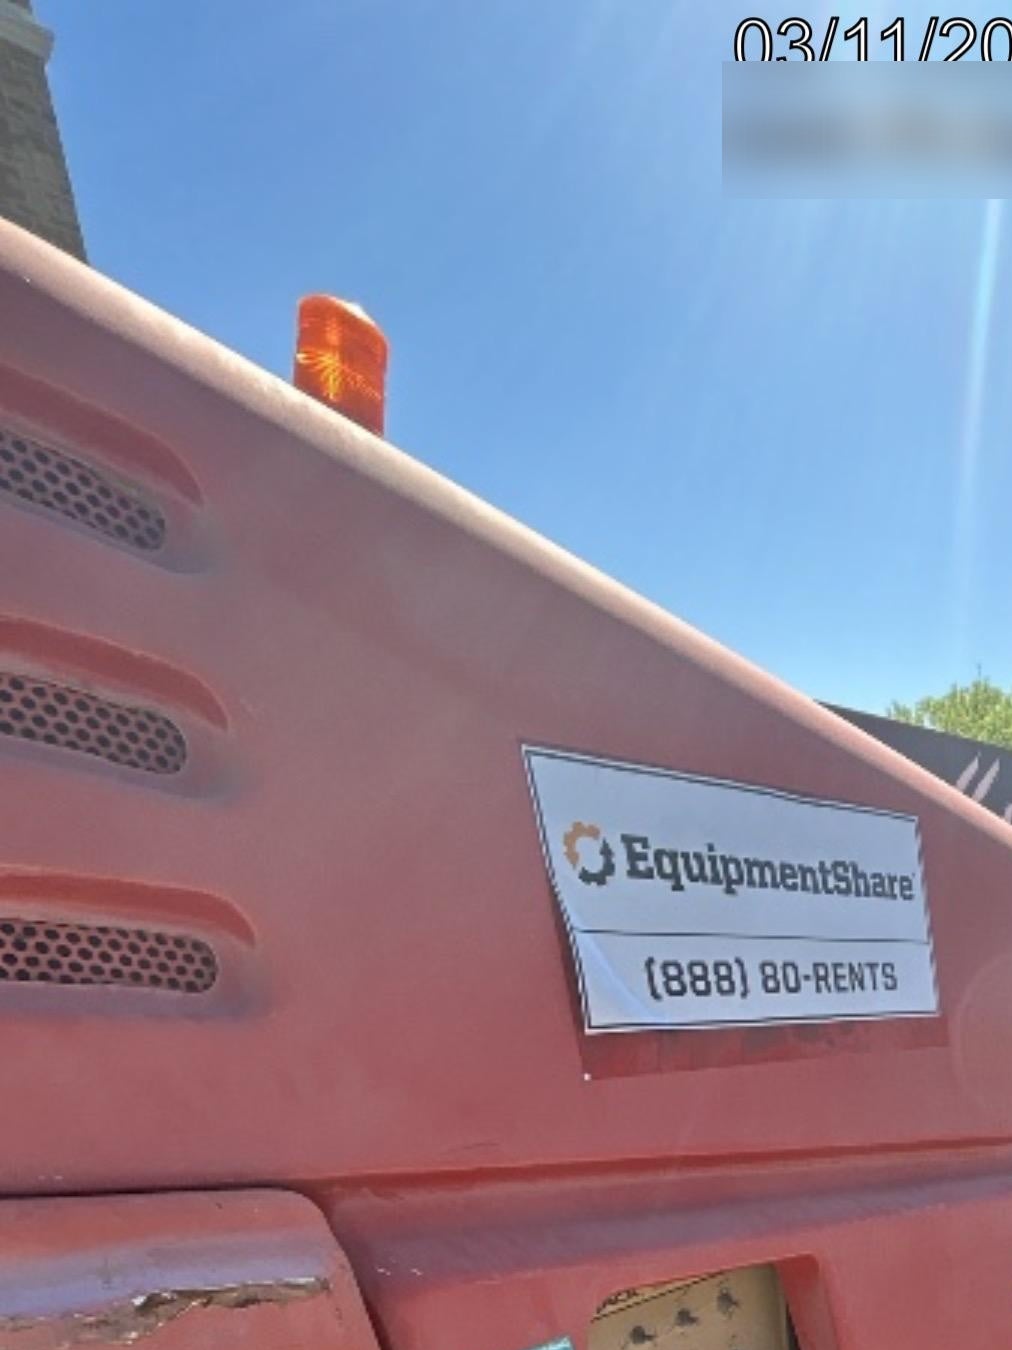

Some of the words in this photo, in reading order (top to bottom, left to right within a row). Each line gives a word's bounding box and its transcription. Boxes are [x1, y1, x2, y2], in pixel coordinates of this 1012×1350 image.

[620, 832, 915, 902] EquipmentShare
[645, 956, 749, 1001] (888)
[759, 960, 898, 995] 80-RENTS
